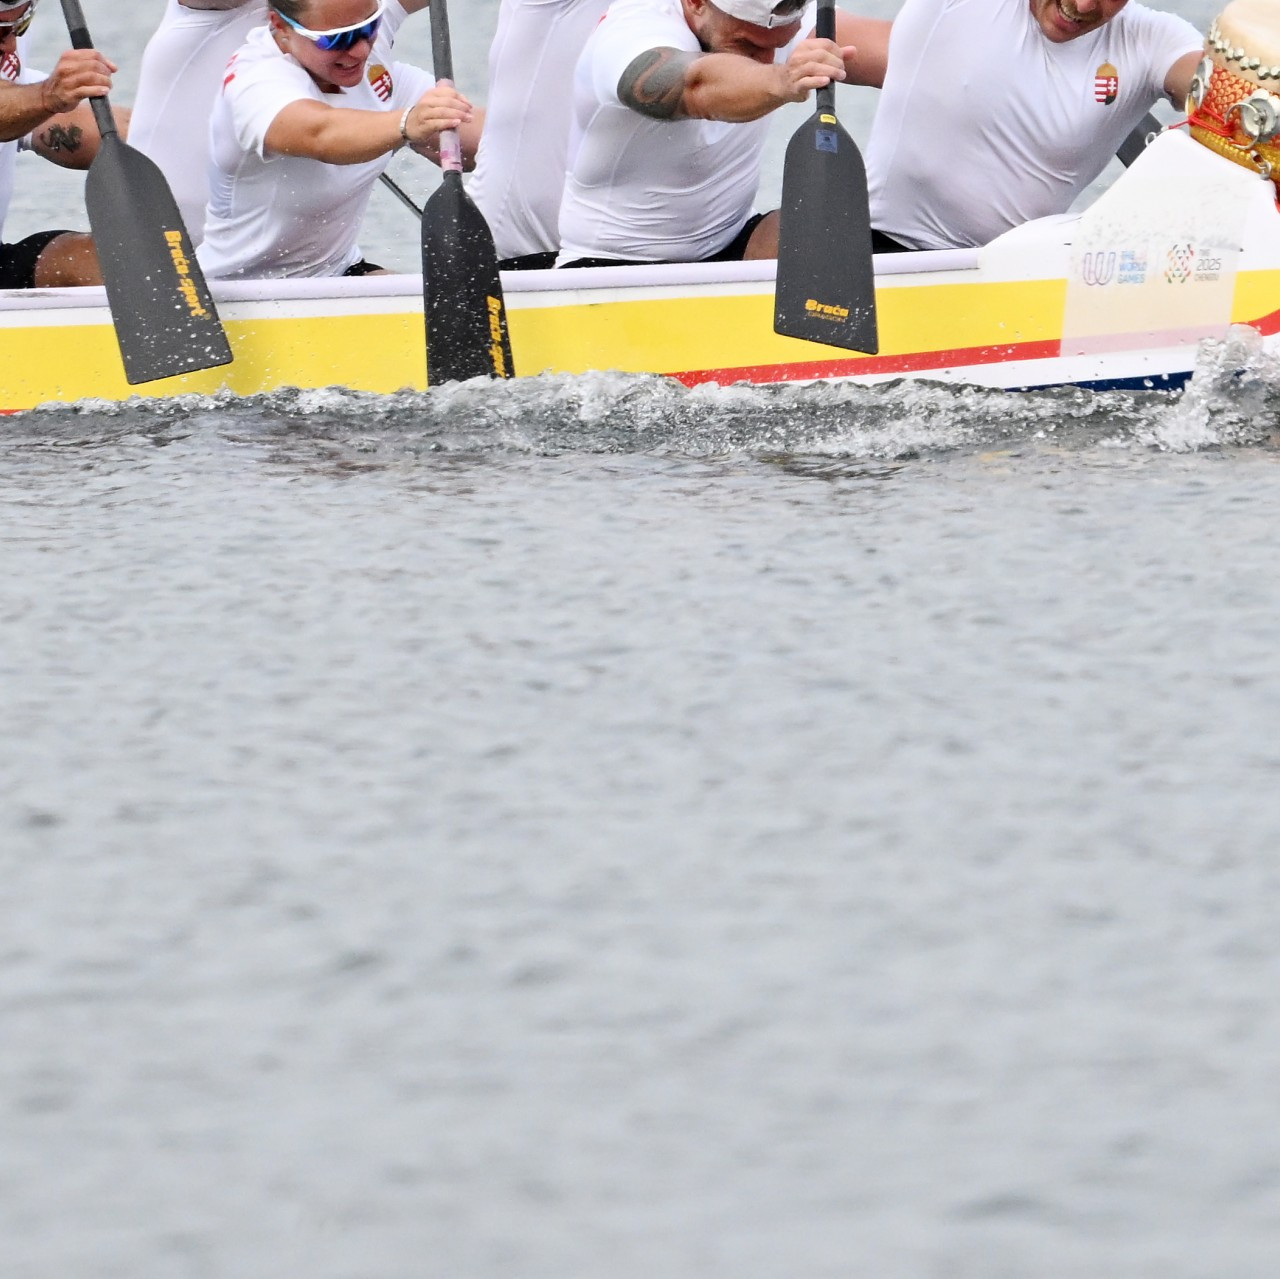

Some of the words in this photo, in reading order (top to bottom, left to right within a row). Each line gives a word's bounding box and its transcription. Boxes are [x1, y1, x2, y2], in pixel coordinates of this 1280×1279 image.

[1119, 261, 1148, 272] WORLD
[1196, 258, 1222, 271] 2025
[1118, 273, 1145, 284] GAMES
